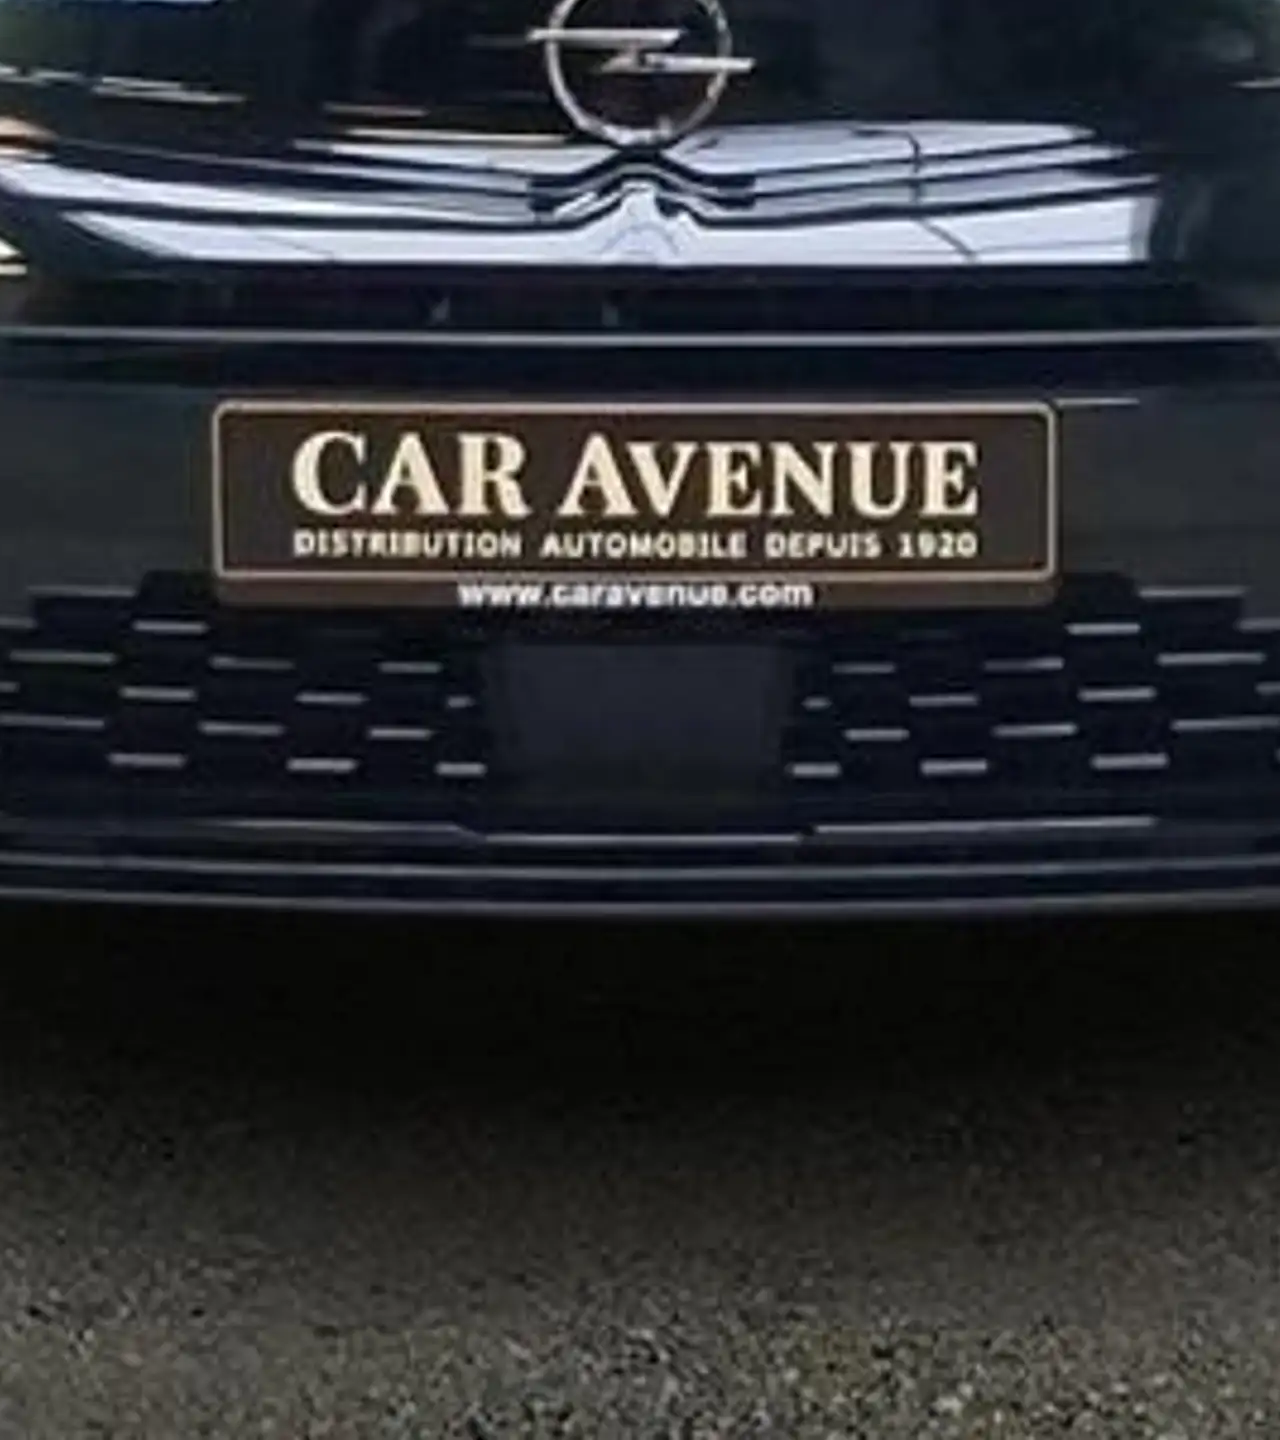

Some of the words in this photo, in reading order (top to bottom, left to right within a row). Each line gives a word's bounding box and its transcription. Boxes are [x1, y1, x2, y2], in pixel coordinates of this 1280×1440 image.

[290, 431, 529, 516] CAR
[559, 432, 979, 516] AVENUE
[294, 529, 522, 558] DISTRIBUTION
[538, 529, 749, 558] AUTOMOBILE
[764, 529, 881, 558] DEPUIS
[899, 529, 979, 558] 1920
[457, 580, 814, 608] www.caravenue.com
